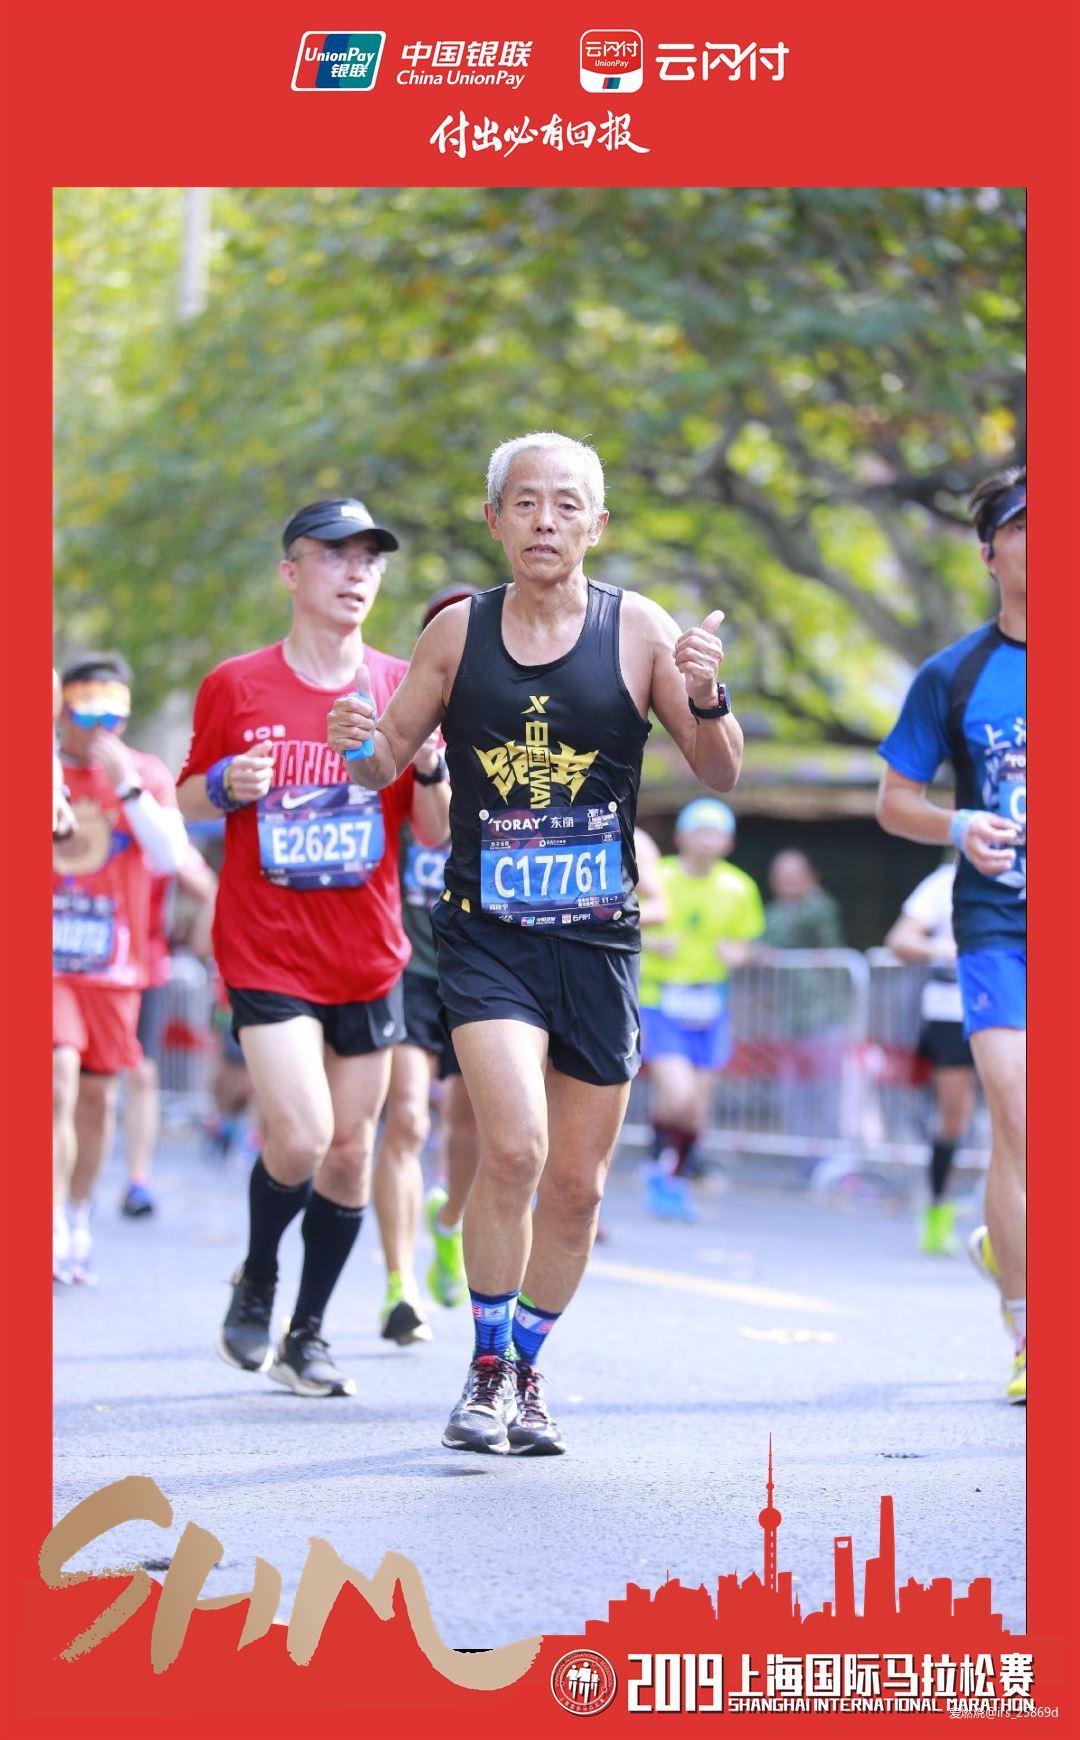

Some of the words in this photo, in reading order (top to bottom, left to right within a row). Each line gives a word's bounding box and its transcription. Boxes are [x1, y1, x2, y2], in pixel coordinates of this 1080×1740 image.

[271, 821, 373, 865] E26257
[550, 816, 574, 829] 东丽
[494, 849, 607, 899] C17761
